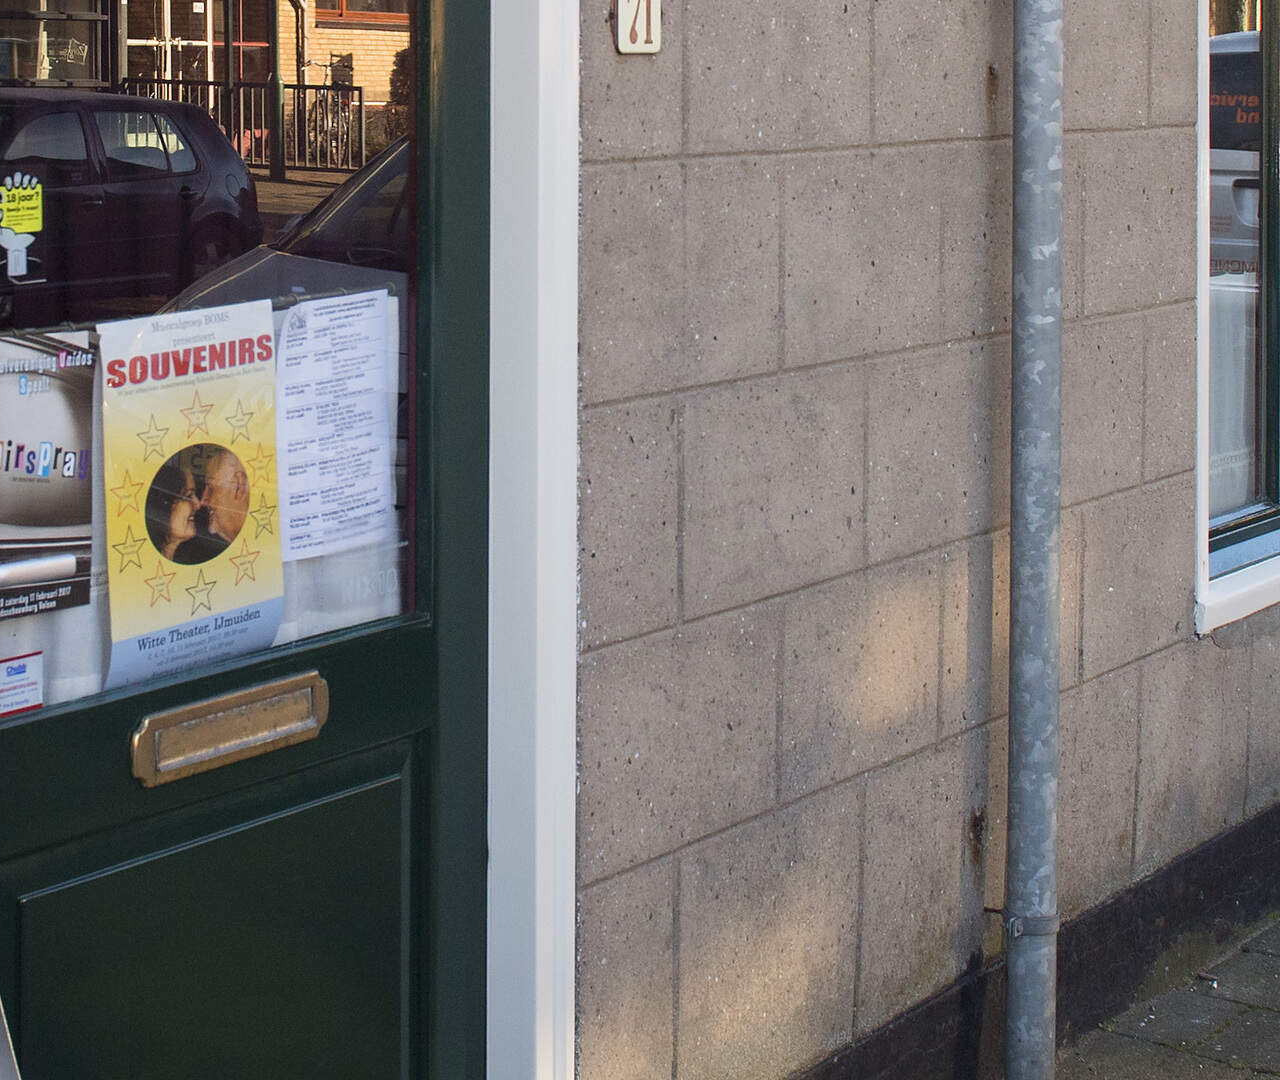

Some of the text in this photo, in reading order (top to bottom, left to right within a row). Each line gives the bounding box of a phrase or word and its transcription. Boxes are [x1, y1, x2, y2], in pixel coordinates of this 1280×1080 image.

[59, 351, 93, 368] Unidos
[107, 334, 274, 388] SOUVENIRS
[19, 376, 51, 397] Speelt
[137, 636, 166, 651] Witte
[169, 624, 211, 643] Theater,
[214, 608, 261, 630] IJmuiden
